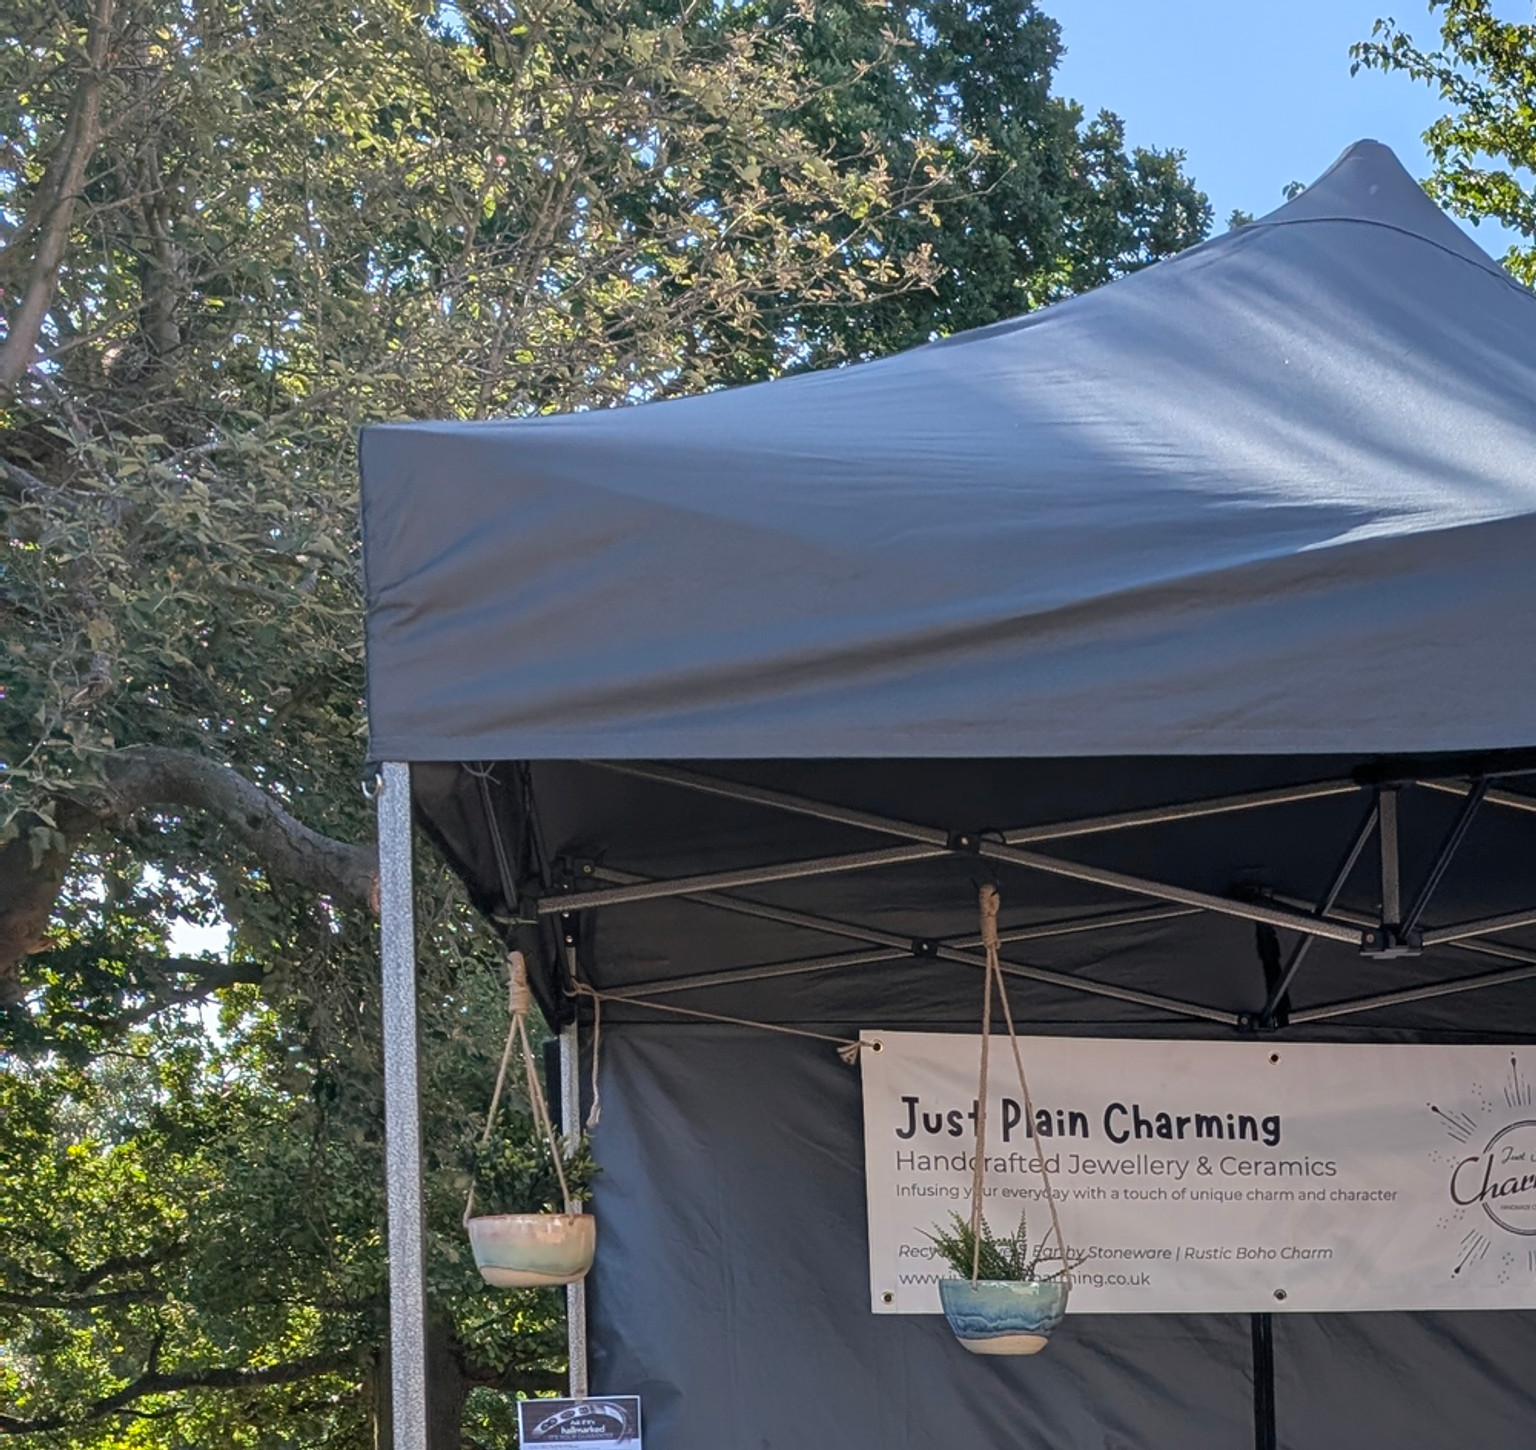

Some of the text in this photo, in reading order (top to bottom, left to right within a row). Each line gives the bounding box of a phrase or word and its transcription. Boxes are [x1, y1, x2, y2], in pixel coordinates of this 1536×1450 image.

[896, 1096, 1281, 1146] Just Plain Charming
[1502, 1146, 1526, 1164] Just
[1068, 1153, 1189, 1181] Jewellery
[1197, 1156, 1213, 1175] &
[1219, 1155, 1337, 1177] Ceramics
[896, 1184, 959, 1200] Infusing
[963, 1187, 999, 1200] yur
[1073, 1187, 1106, 1200] with
[1110, 1190, 1119, 1200] a
[1123, 1188, 1168, 1201] touch
[1171, 1187, 1186, 1200] of
[1190, 1188, 1242, 1204] unique
[1246, 1188, 1295, 1202] charm
[1298, 1188, 1327, 1202] and
[1329, 1188, 1398, 1203] character
[1088, 1246, 1172, 1260] Stoneware
[1185, 1246, 1232, 1260] Rustic
[1236, 1246, 1276, 1260] Boho
[1280, 1246, 1333, 1261] Charm
